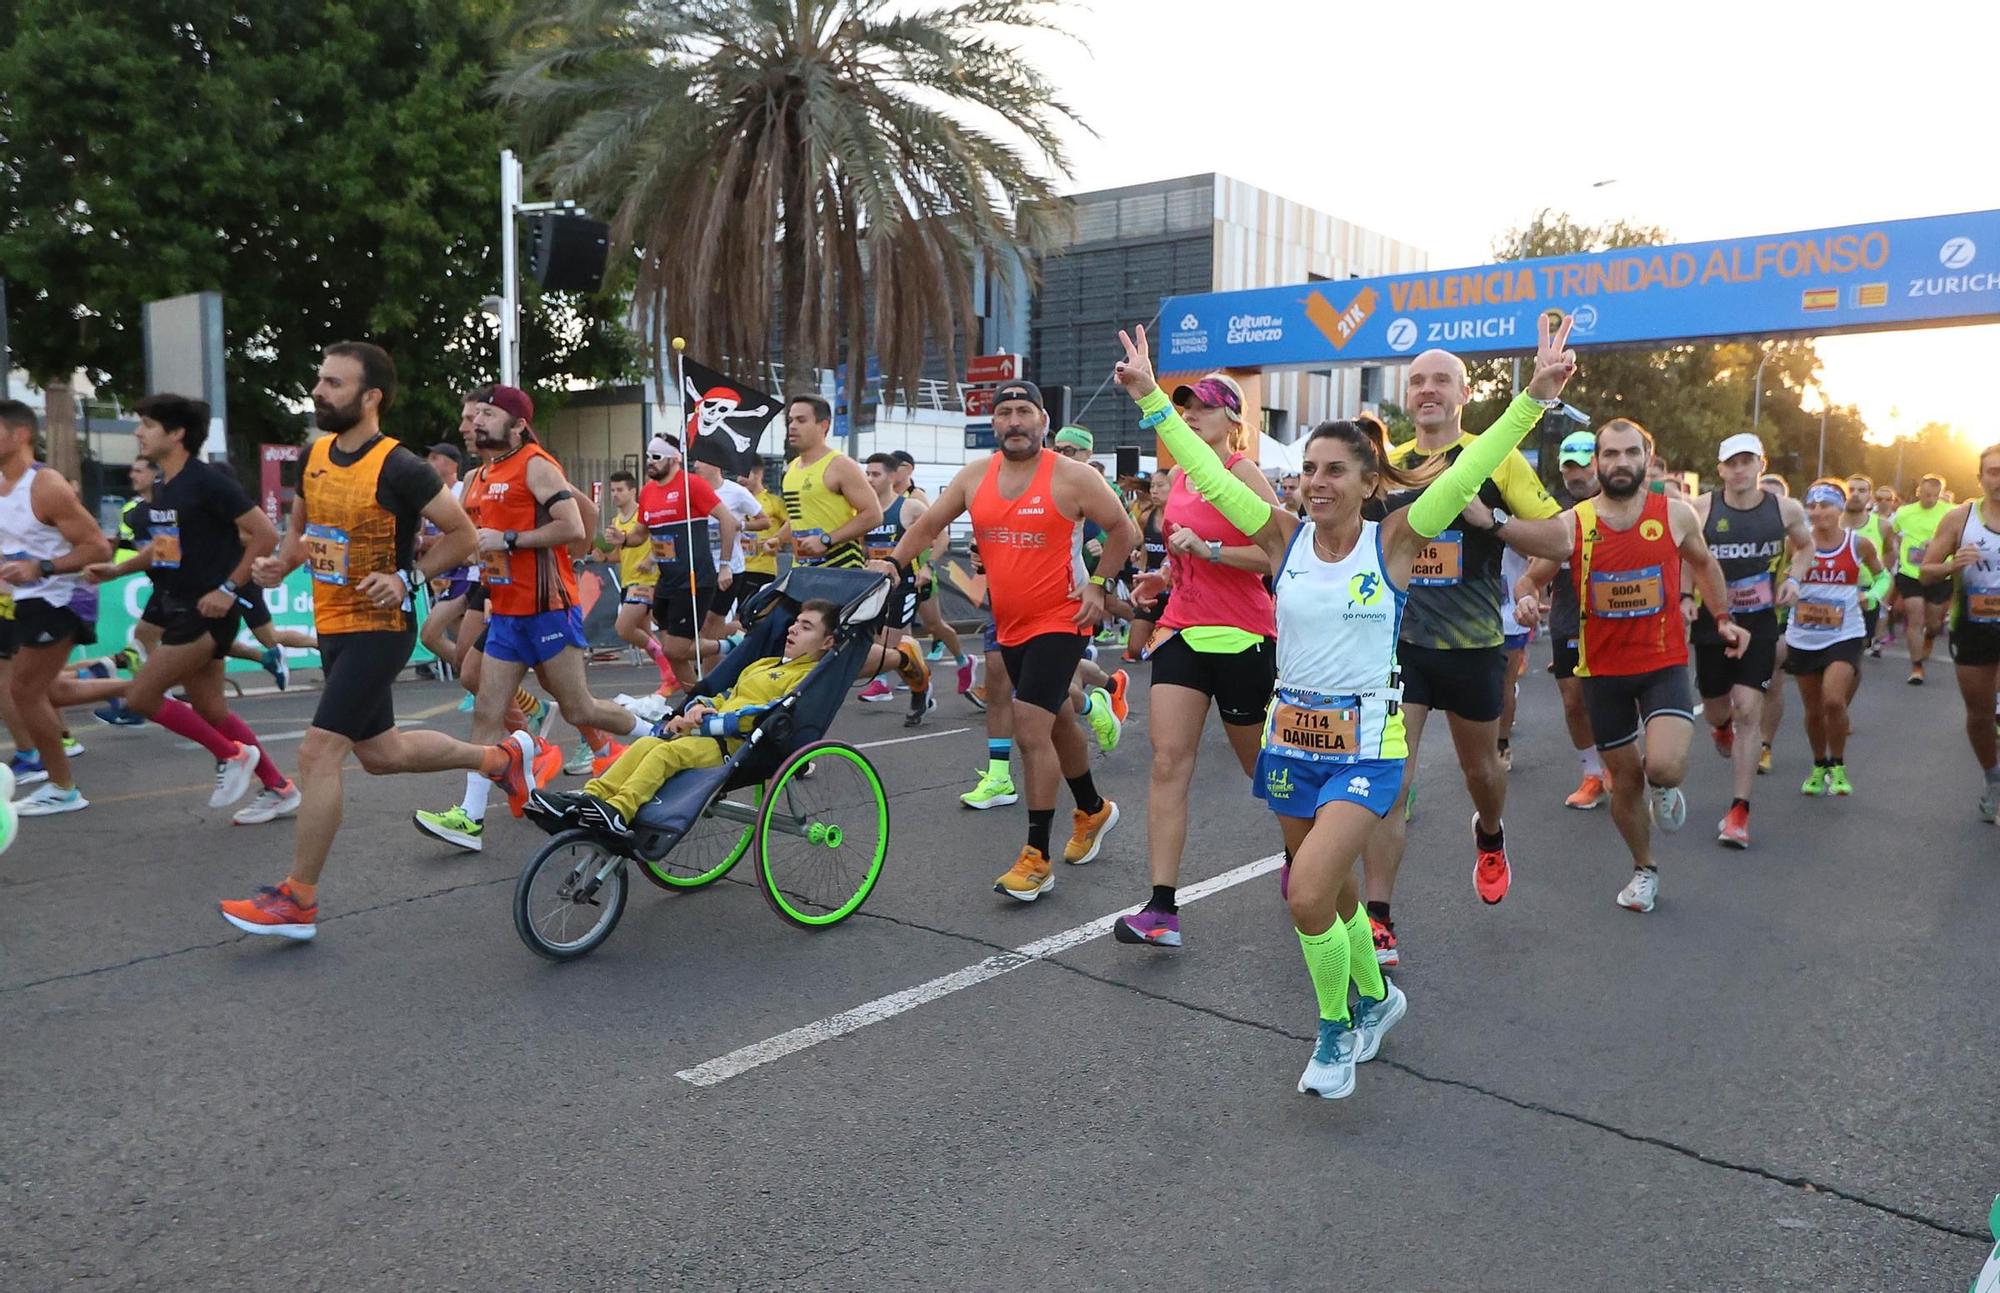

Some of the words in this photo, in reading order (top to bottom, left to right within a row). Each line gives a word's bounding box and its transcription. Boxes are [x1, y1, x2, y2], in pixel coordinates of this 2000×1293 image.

[1390, 267, 1536, 312] VALENCIA
[1540, 252, 1697, 298] TRINIDAD
[1699, 231, 1890, 286] ALFONSO
[1908, 272, 2000, 298] ZURICH
[1228, 314, 1271, 329] Cultura
[1337, 303, 1366, 339] 21K
[1427, 316, 1516, 342] ZURICH
[1227, 327, 1283, 345] Esfuerzo
[1608, 598, 1648, 609] Tomeu
[1342, 613, 1354, 621] go
[1355, 612, 1387, 621] running
[1295, 711, 1330, 730] 7114
[1283, 728, 1346, 750] DANIELA
